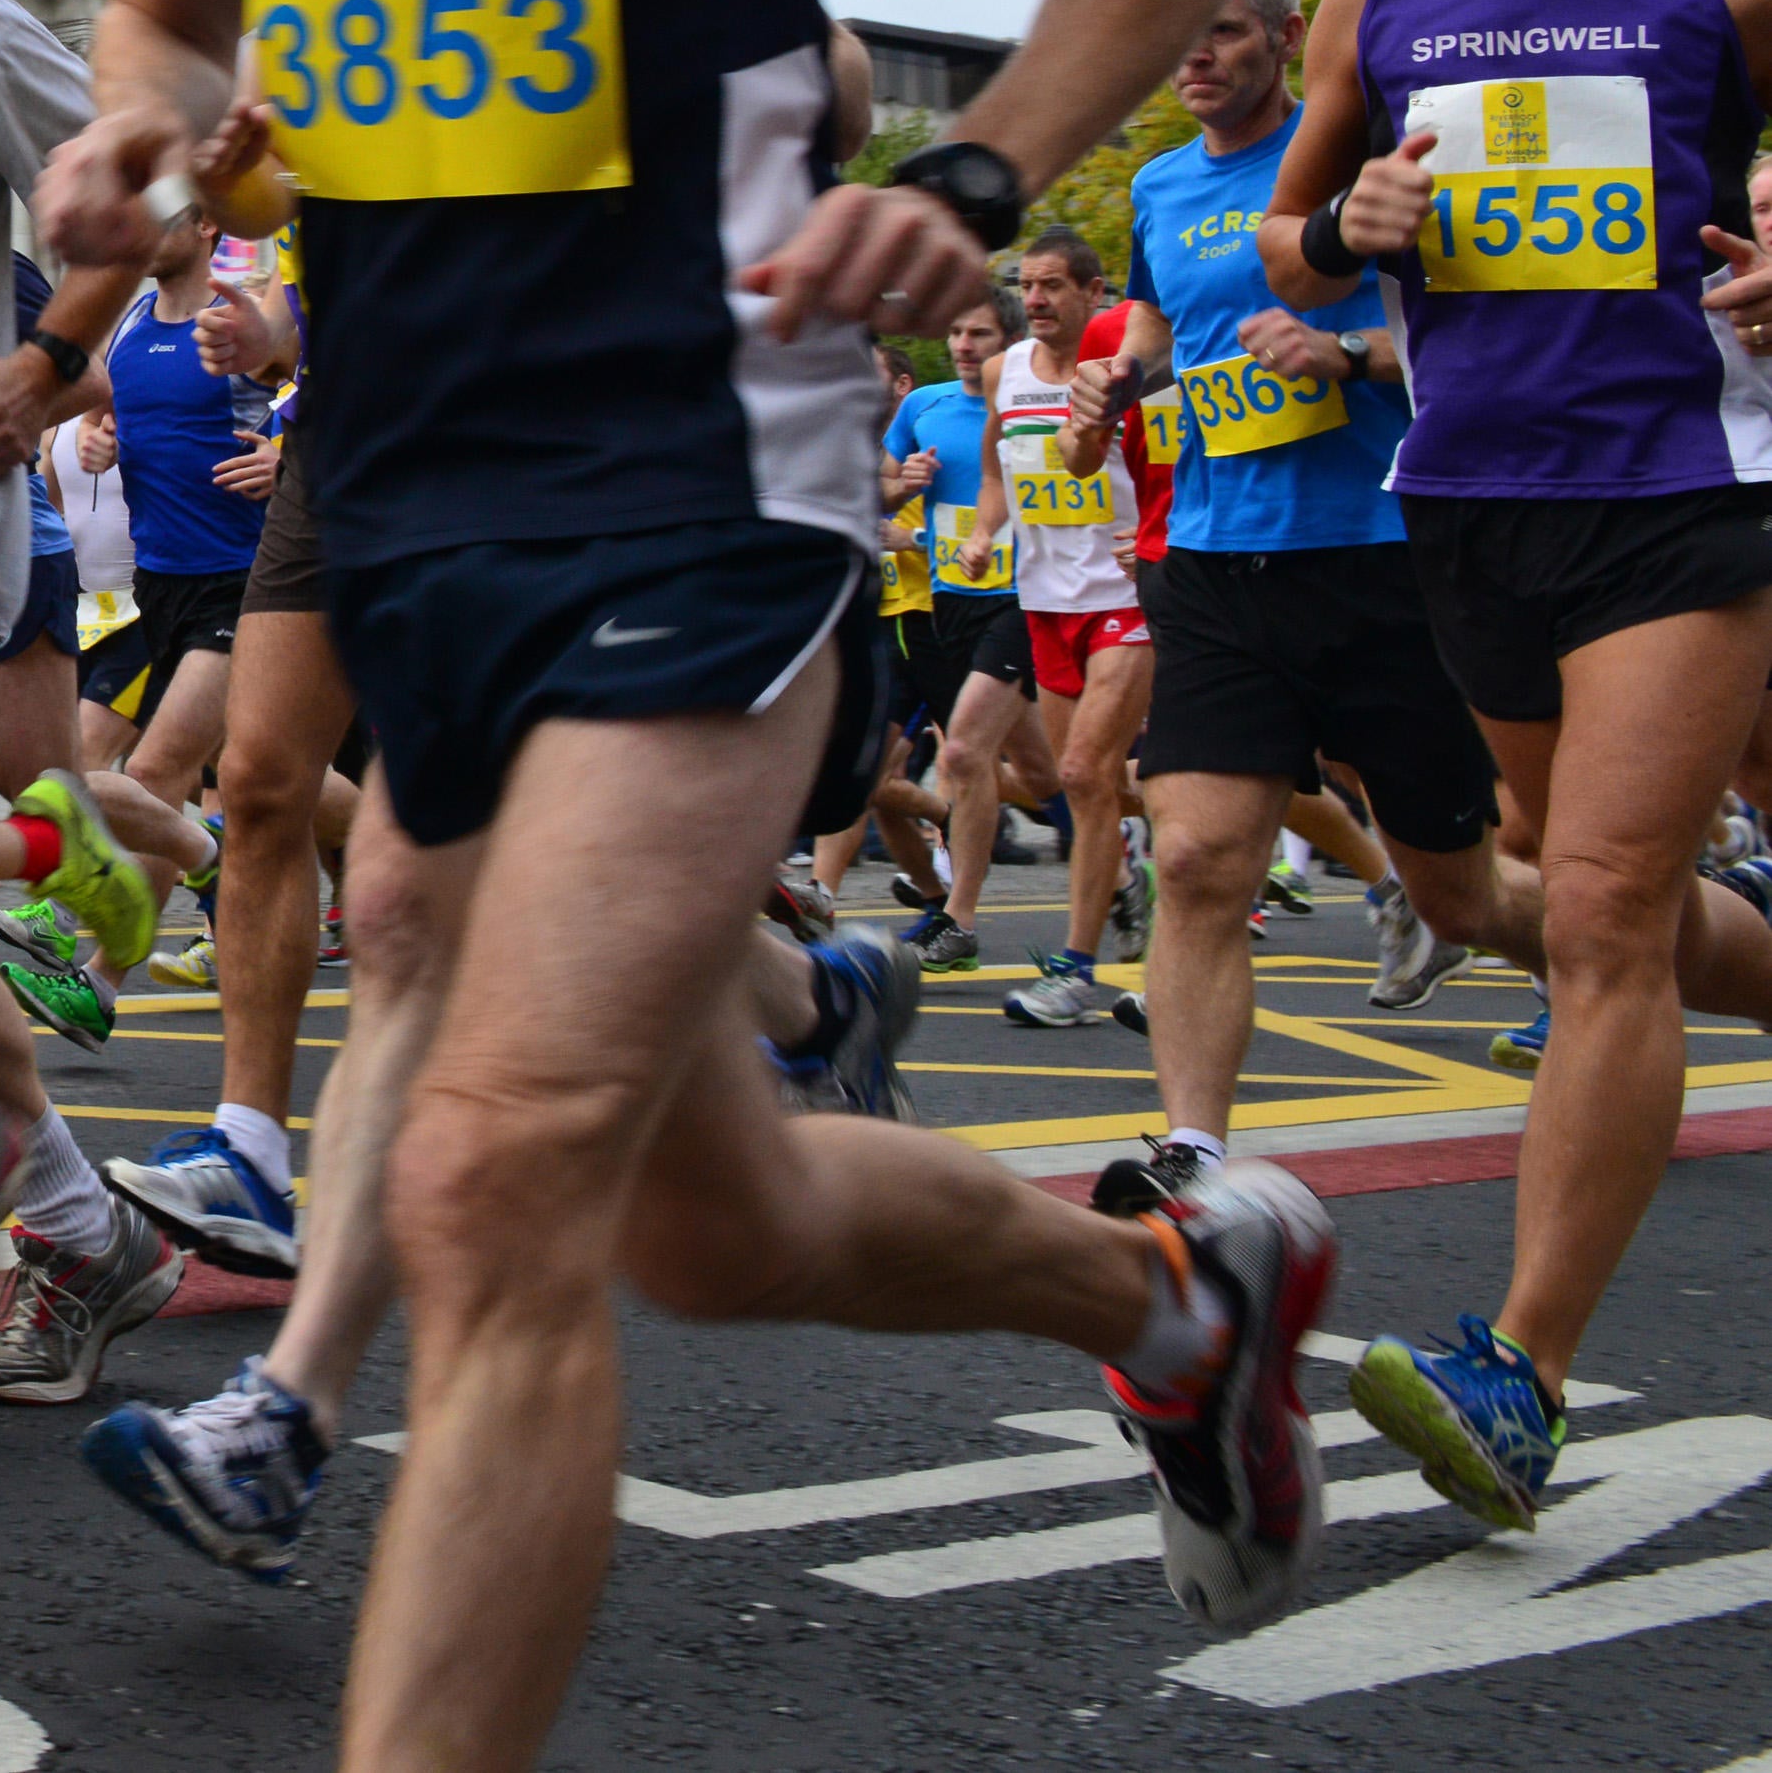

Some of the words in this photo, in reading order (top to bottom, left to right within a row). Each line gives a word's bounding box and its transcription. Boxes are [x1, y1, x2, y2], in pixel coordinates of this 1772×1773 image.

[1412, 25, 1661, 63] SPRINGWELL
[1178, 210, 1265, 248] TCRS
[1430, 182, 1647, 258] 1558
[1197, 239, 1242, 261] 2009
[1018, 478, 1105, 510] 2131
[937, 540, 1004, 575] 341
